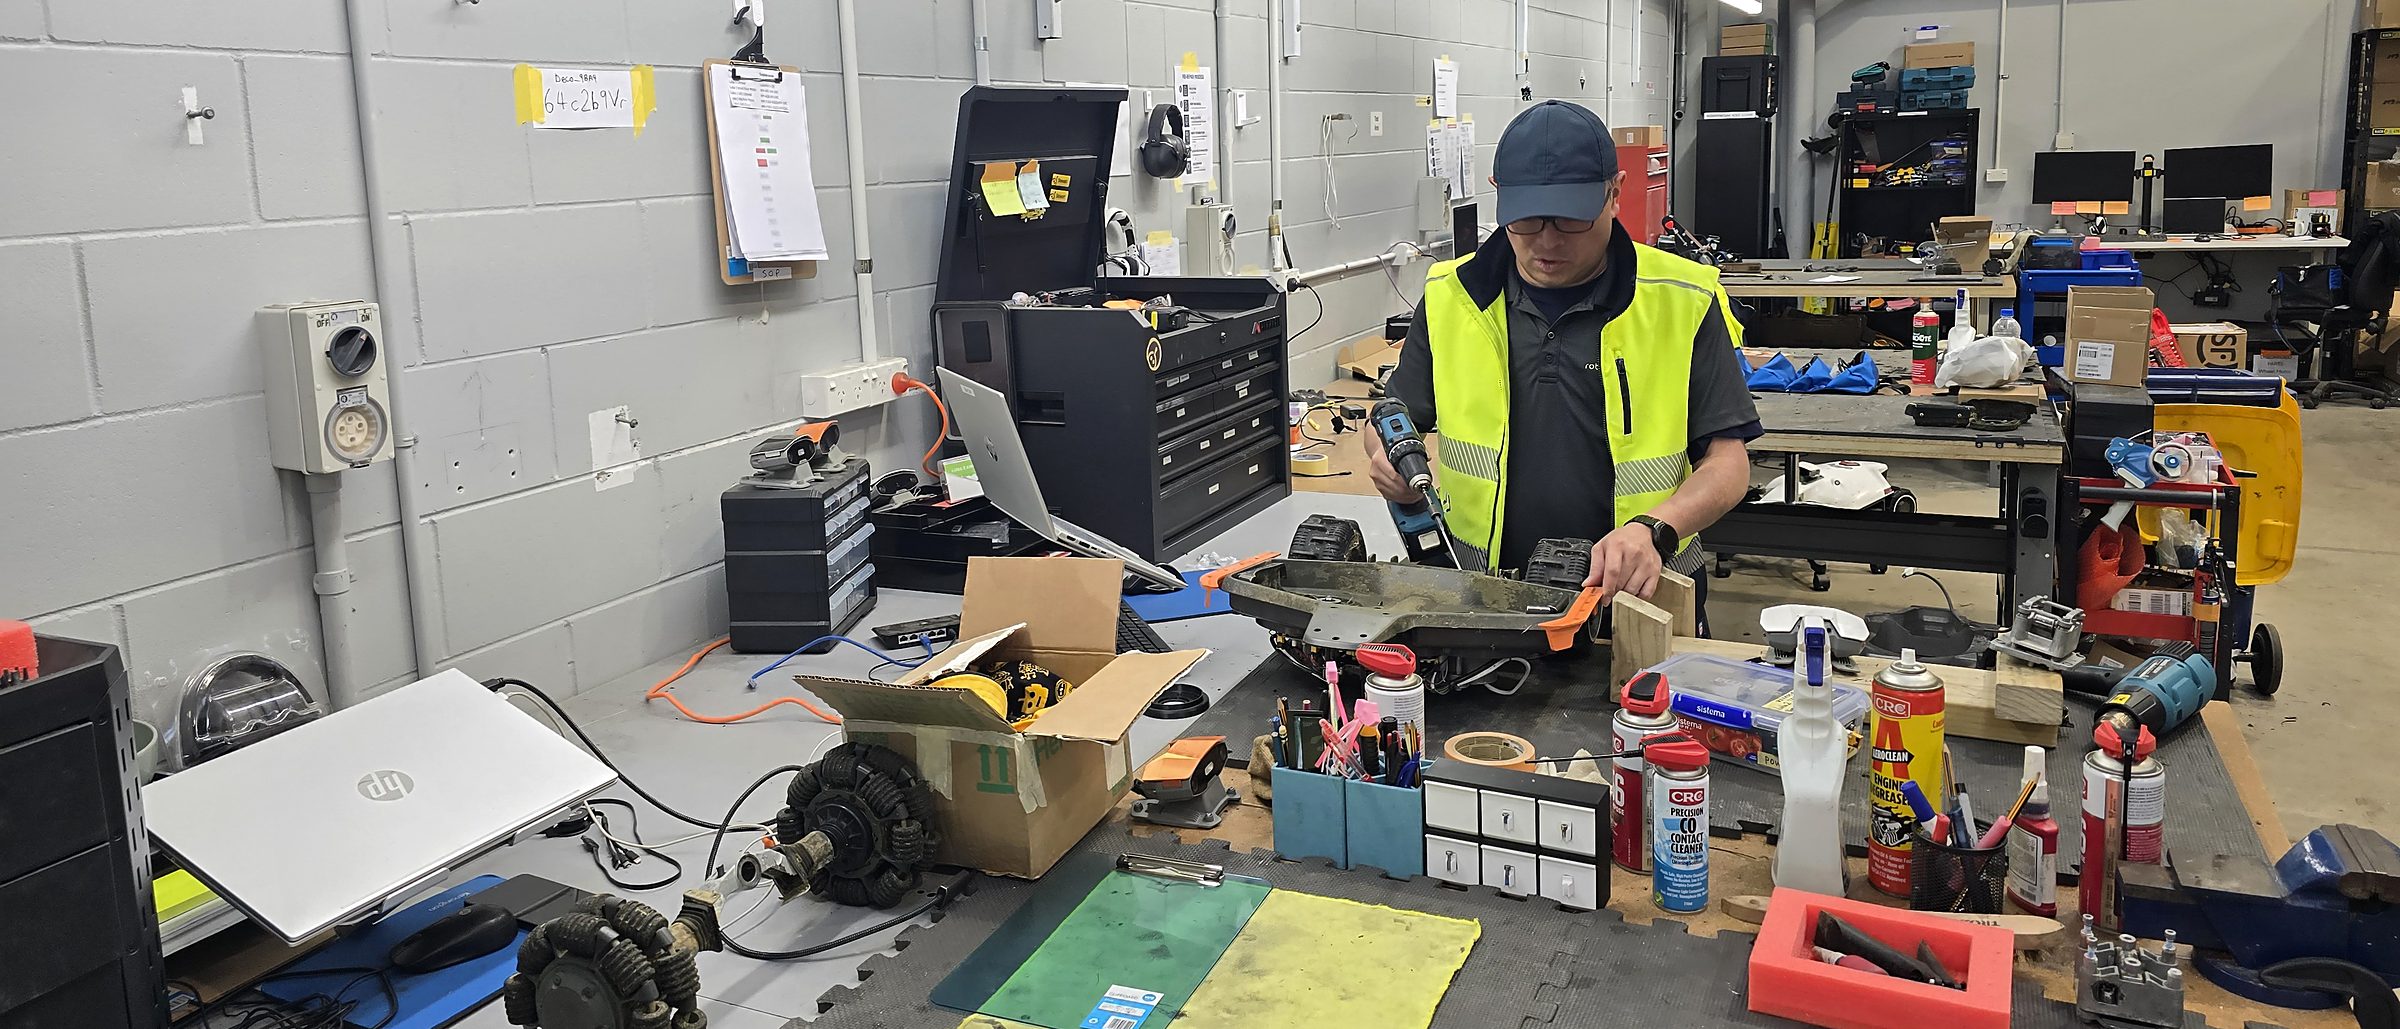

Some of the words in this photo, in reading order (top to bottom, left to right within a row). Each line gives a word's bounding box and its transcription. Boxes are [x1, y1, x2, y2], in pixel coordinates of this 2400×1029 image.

[762, 269, 780, 279] SOP
[316, 319, 329, 328] OFF
[361, 314, 370, 322] ON
[1696, 704, 1726, 719] sistema
[1875, 697, 1906, 715] CRC
[1677, 716, 1703, 731] istema
[1873, 748, 1909, 762] AEROCLEAN
[1671, 790, 1704, 803] CRC
[1670, 807, 1704, 818] PRECISION
[1680, 817, 1697, 834] CO
[1670, 832, 1704, 845] CONTACT
[1670, 843, 1704, 854] CLEANER
